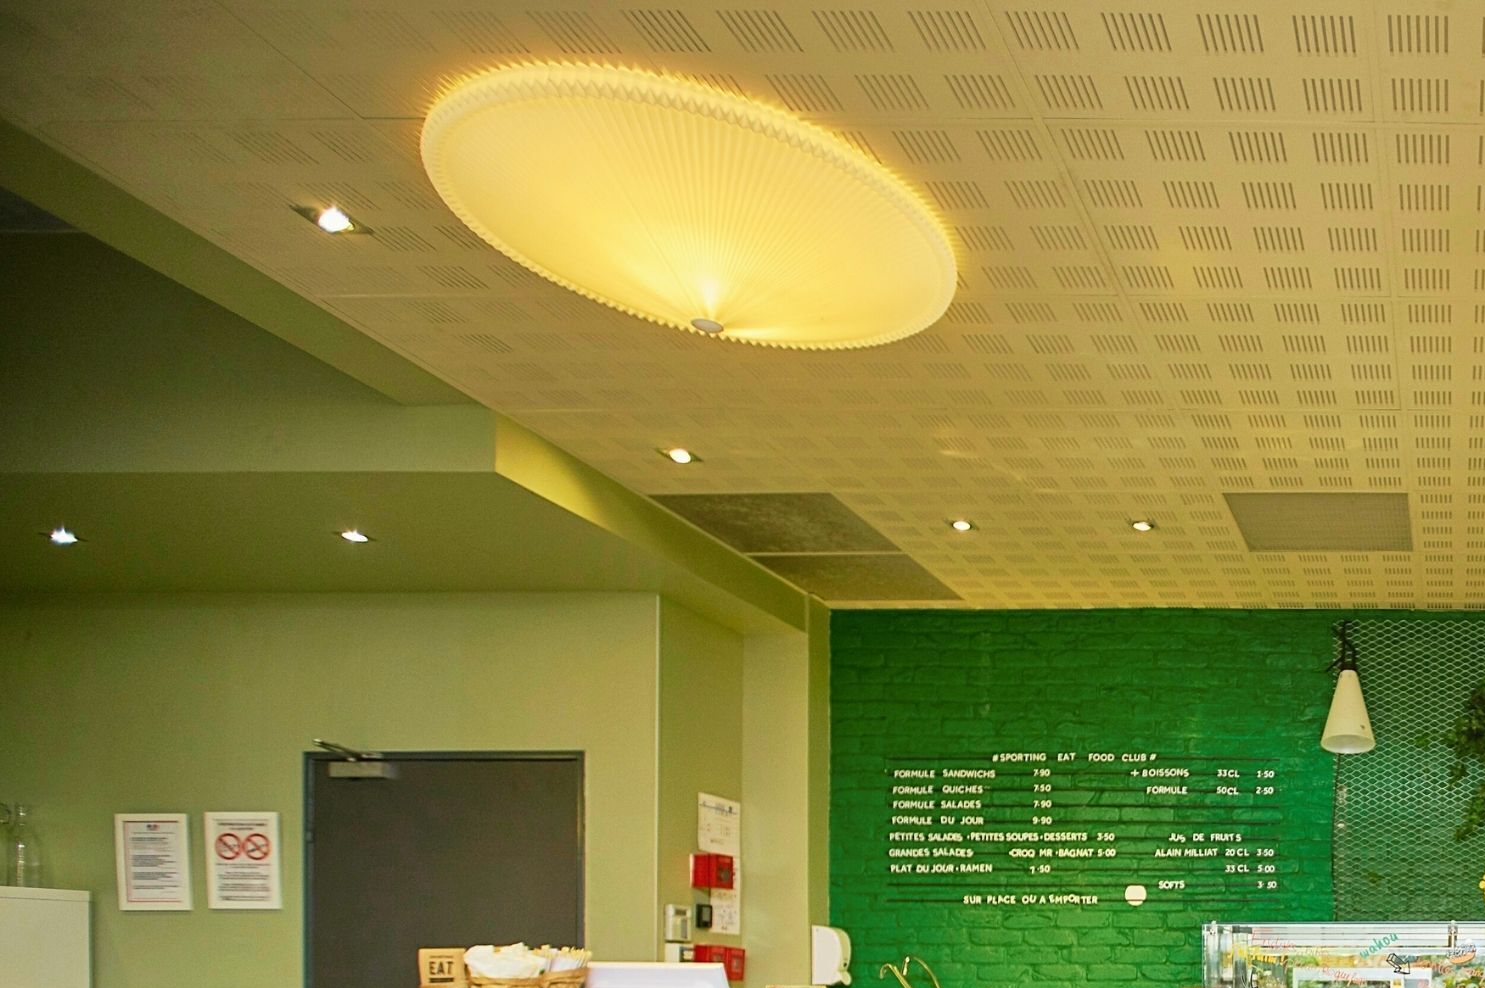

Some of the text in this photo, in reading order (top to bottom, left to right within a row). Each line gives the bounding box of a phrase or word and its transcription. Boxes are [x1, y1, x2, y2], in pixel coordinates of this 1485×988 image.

[1058, 753, 1075, 761] EAT
[1089, 753, 1114, 761] FOOD
[1122, 754, 1146, 762] CLUB
[895, 770, 934, 778] FORMULE
[943, 769, 995, 778] SANDWICHS
[1142, 769, 1189, 777] BOISSONS
[1218, 769, 1239, 777] 33CL
[893, 786, 933, 794] FORMULE
[943, 785, 983, 793] QUICHES
[1147, 786, 1187, 794] FORMULE
[1217, 786, 1238, 795] 50CL
[893, 801, 934, 809] FORMULE
[941, 800, 981, 808] SALADES
[892, 816, 932, 825] FORMULE
[941, 816, 954, 824] DU
[961, 816, 983, 824] JOUR
[928, 833, 963, 841] SALADES
[1006, 833, 1039, 841] SOUPES
[1169, 833, 1185, 842] JUS
[1193, 833, 1204, 841] DE
[889, 848, 929, 857] GRANDES
[933, 848, 973, 857] SALADES
[1040, 849, 1052, 857] MR
[1155, 849, 1181, 857] ALAIN
[1184, 848, 1218, 856] MILLIAT
[891, 864, 912, 872] PLAT
[916, 865, 929, 873] DU
[931, 864, 954, 873] JOUR
[1159, 880, 1184, 889] SOFTS
[964, 895, 981, 904] SUR
[987, 895, 1015, 904] PLACE
[1022, 895, 1037, 904] OU
[1049, 894, 1098, 904] EMPORTER
[429, 961, 453, 975] EAT
